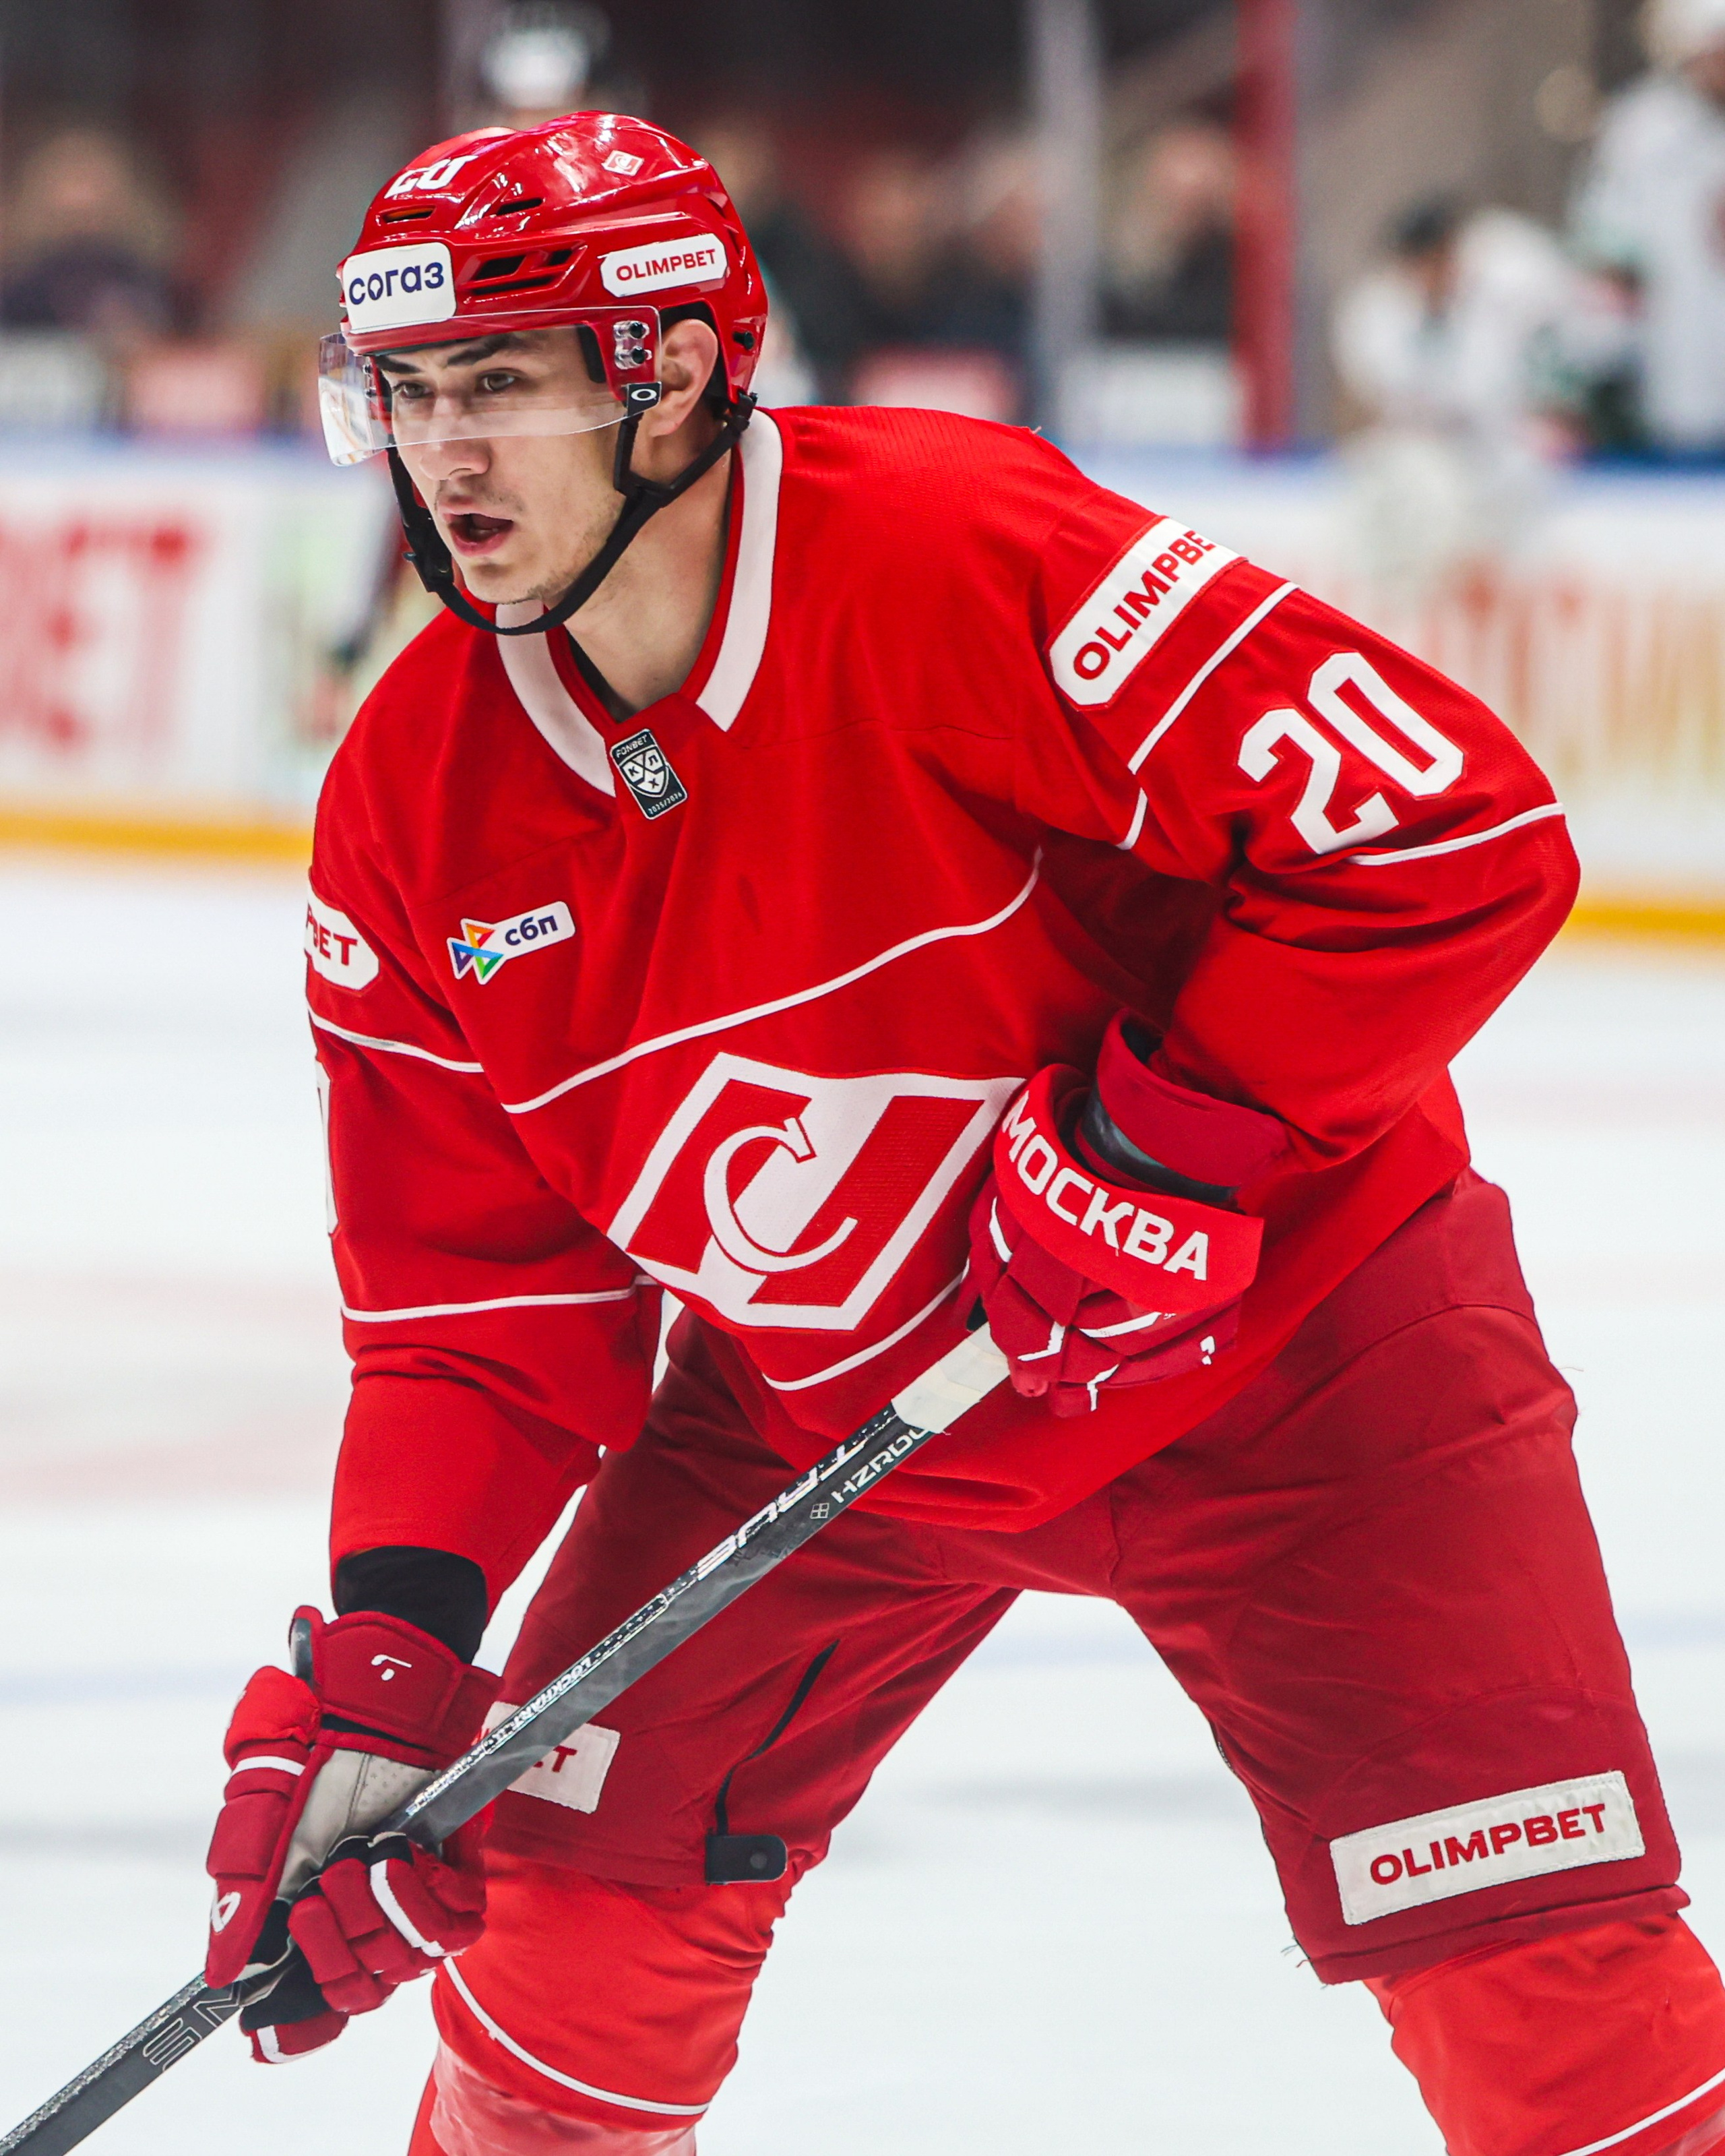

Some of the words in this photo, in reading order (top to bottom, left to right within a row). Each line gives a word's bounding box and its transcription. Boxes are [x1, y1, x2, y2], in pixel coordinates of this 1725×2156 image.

[349, 261, 444, 305] согаз
[616, 249, 715, 281] OLIMPBET
[1073, 530, 1216, 680] OLIMPBE
[616, 734, 648, 758] FONBET
[1237, 652, 1464, 855] 20
[648, 791, 683, 815] 2025/2026
[505, 915, 559, 946] сбп
[1002, 1090, 1209, 1281] МОСКВА
[1371, 1804, 1606, 1885] OLIMPBET
